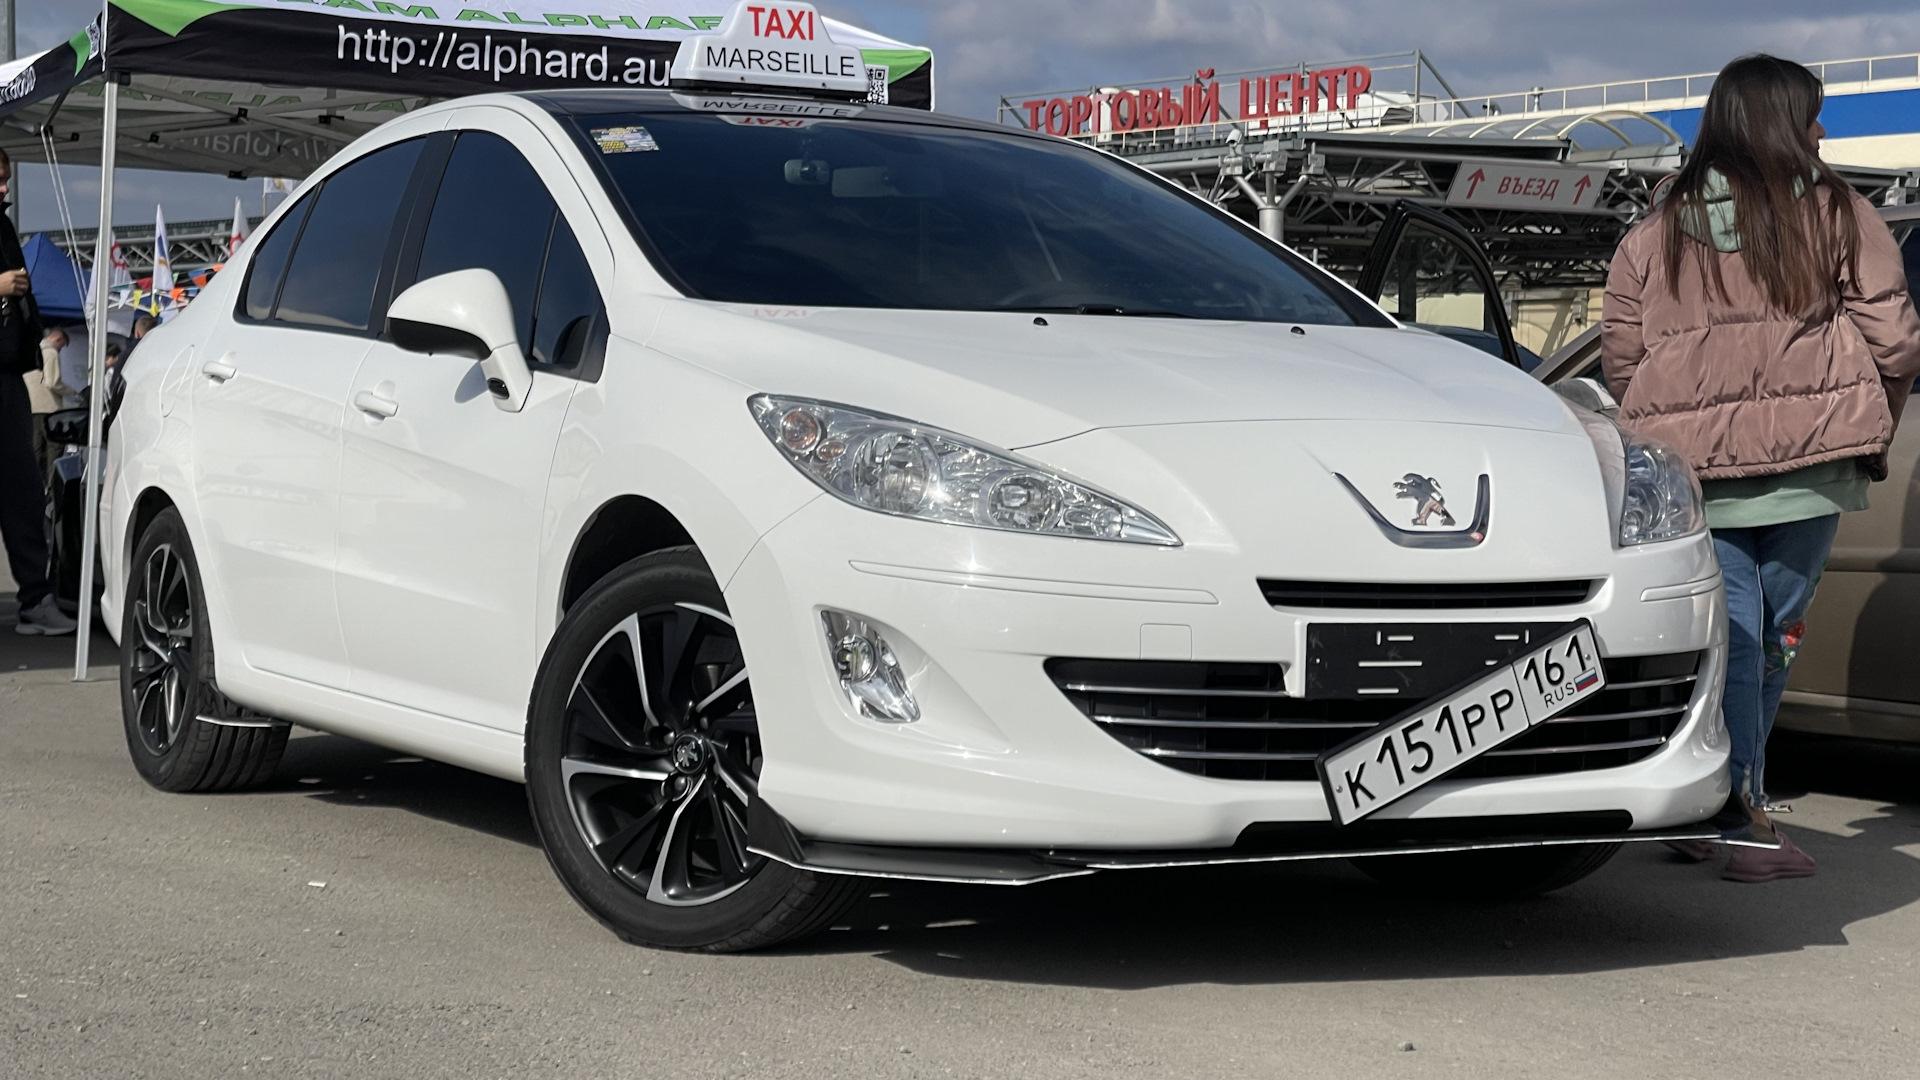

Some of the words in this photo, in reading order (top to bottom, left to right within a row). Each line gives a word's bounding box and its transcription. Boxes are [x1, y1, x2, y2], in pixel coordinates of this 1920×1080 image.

[747, 6, 814, 41] TAXI
[707, 46, 856, 77] MARSEILLE
[1022, 68, 1220, 137] ТОРГОВЫЙ
[1239, 65, 1372, 129] ЦЕНТР
[1497, 176, 1559, 200] ВЪЕЗД
[1522, 633, 1587, 695] 161
[1543, 682, 1575, 708] RUS
